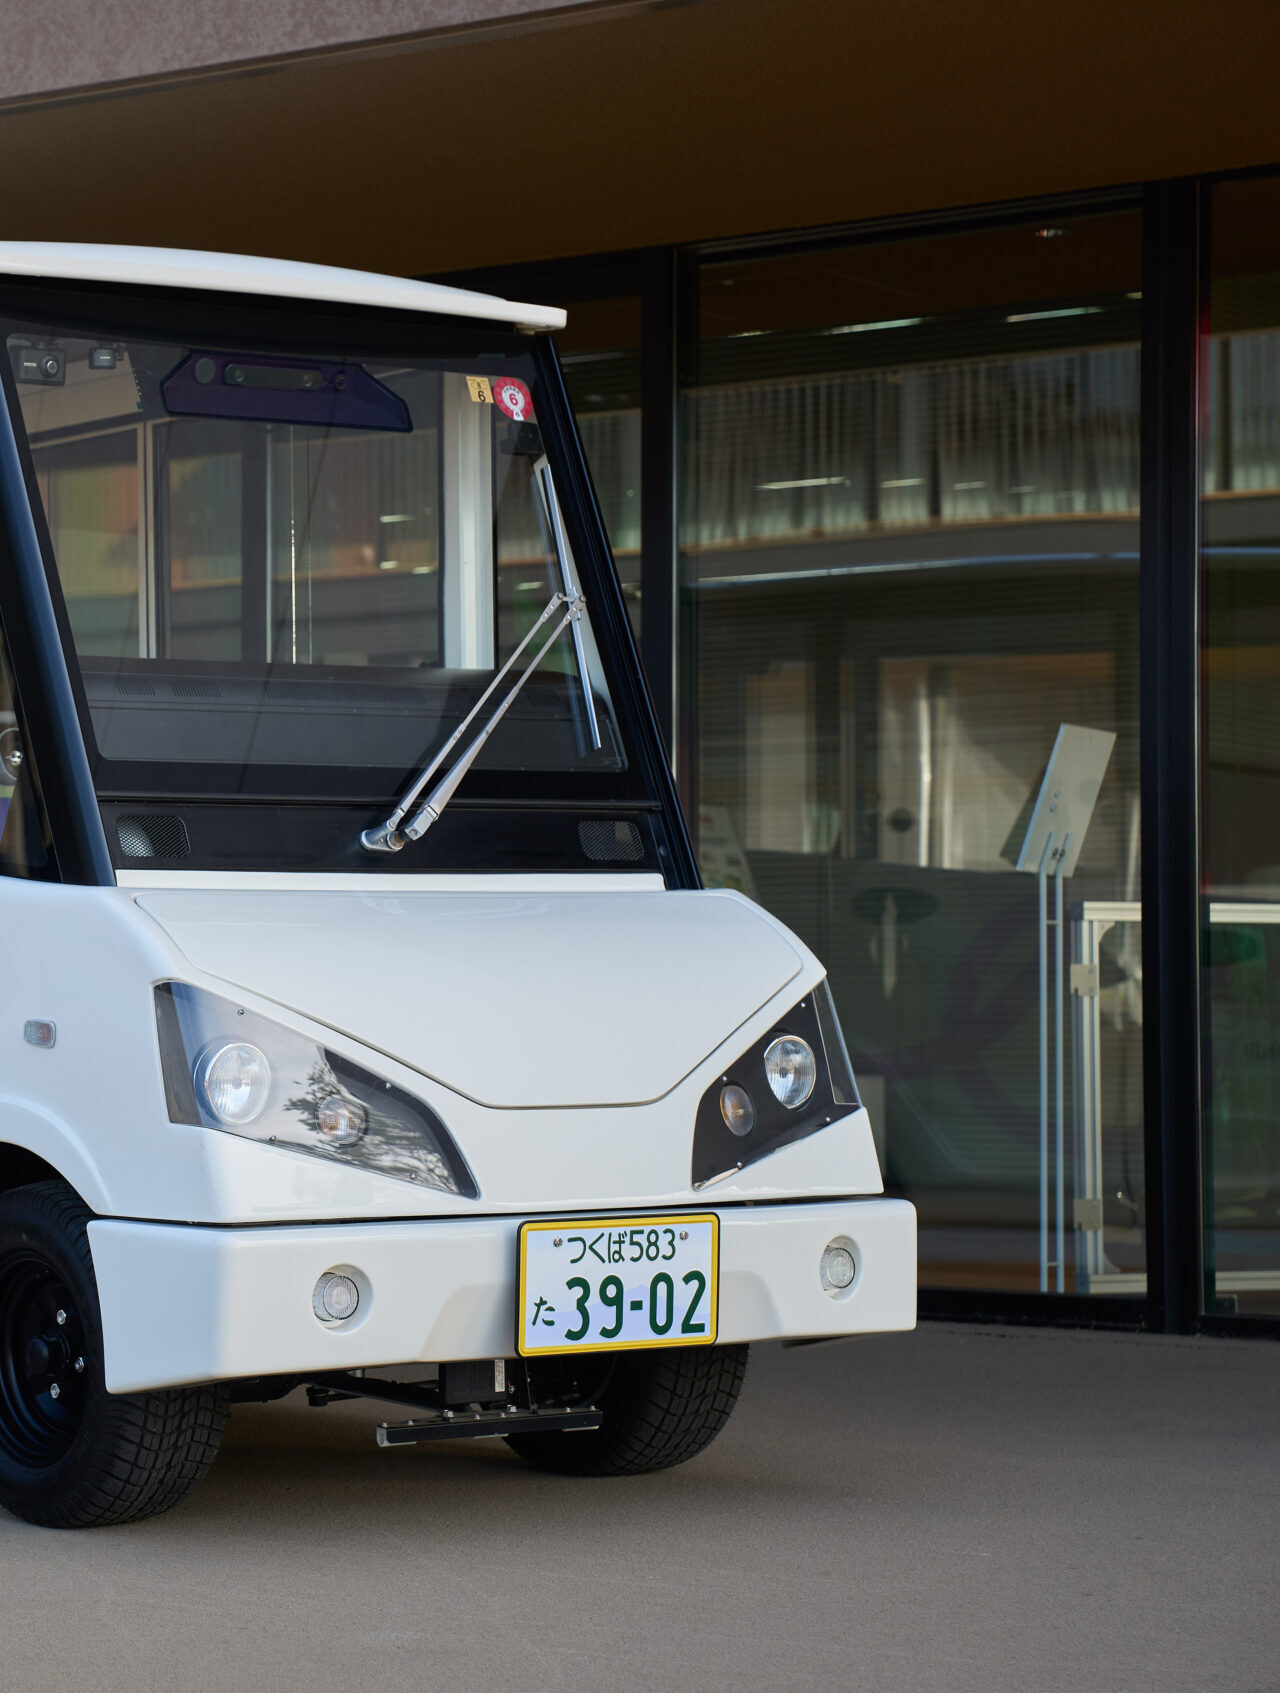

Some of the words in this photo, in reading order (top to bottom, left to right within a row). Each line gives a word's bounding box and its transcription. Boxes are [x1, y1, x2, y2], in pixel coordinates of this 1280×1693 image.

[478, 391, 486, 402] 6
[509, 393, 518, 406] 6
[567, 1228, 676, 1264] つくば583
[532, 1296, 555, 1326] た
[565, 1270, 706, 1340] 39-02
